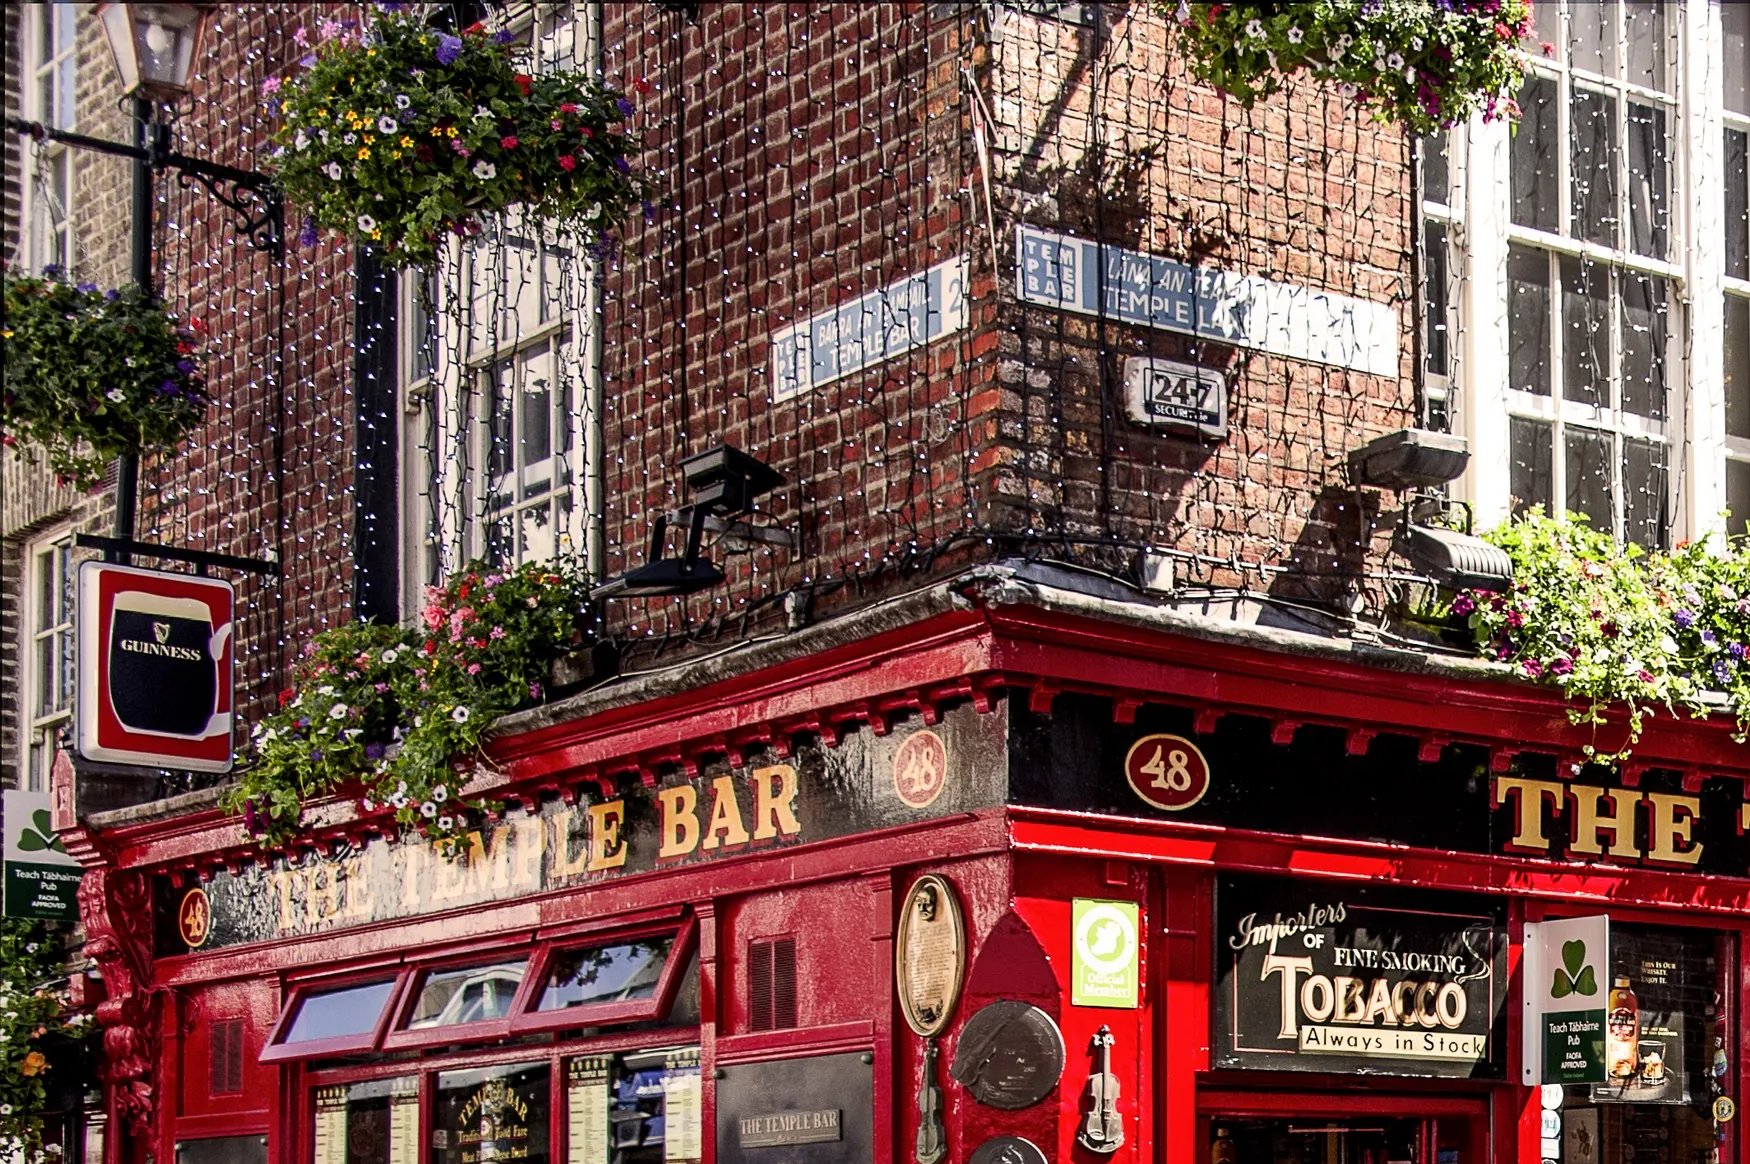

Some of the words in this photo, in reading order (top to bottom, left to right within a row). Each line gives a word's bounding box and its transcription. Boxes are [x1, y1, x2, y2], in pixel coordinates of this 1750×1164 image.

[1028, 274, 1075, 303] BAR
[1159, 270, 1185, 293] AN
[818, 316, 852, 347] BARRA
[877, 283, 932, 323] TEAMPAIL
[949, 278, 961, 314] 2
[830, 329, 884, 371] TEMPLE
[890, 316, 920, 348] BAR
[121, 638, 201, 661] GUINNESS
[1140, 744, 1191, 793] 48
[1497, 776, 1704, 865] THE
[271, 855, 375, 930] THE
[398, 800, 626, 905] TEMPLE
[658, 763, 801, 859] BAR
[902, 744, 936, 794] 48
[15, 869, 40, 881] Teach
[40, 881, 57, 892] Pub
[187, 897, 205, 939] 48
[1229, 902, 1346, 954] Importers
[1303, 933, 1325, 949] OF
[1334, 947, 1379, 969] FINE
[1382, 950, 1466, 975] SMOKING
[1663, 962, 1676, 970] OUR
[1087, 971, 1125, 986] Official
[1082, 983, 1129, 998] Member
[1260, 954, 1467, 1040] TOBACCO
[1549, 1022, 1568, 1033] Teach
[1305, 1027, 1383, 1050] Always
[1395, 1034, 1413, 1051] in
[1422, 1034, 1485, 1054] Stock
[1567, 1035, 1581, 1046] Pub
[1561, 1060, 1587, 1069] APPROVED
[507, 1087, 528, 1122] BAR
[513, 1124, 528, 1137] Fare
[741, 1118, 761, 1134] THE
[765, 1114, 810, 1133] TEMPLE
[813, 1111, 837, 1128] BAR
